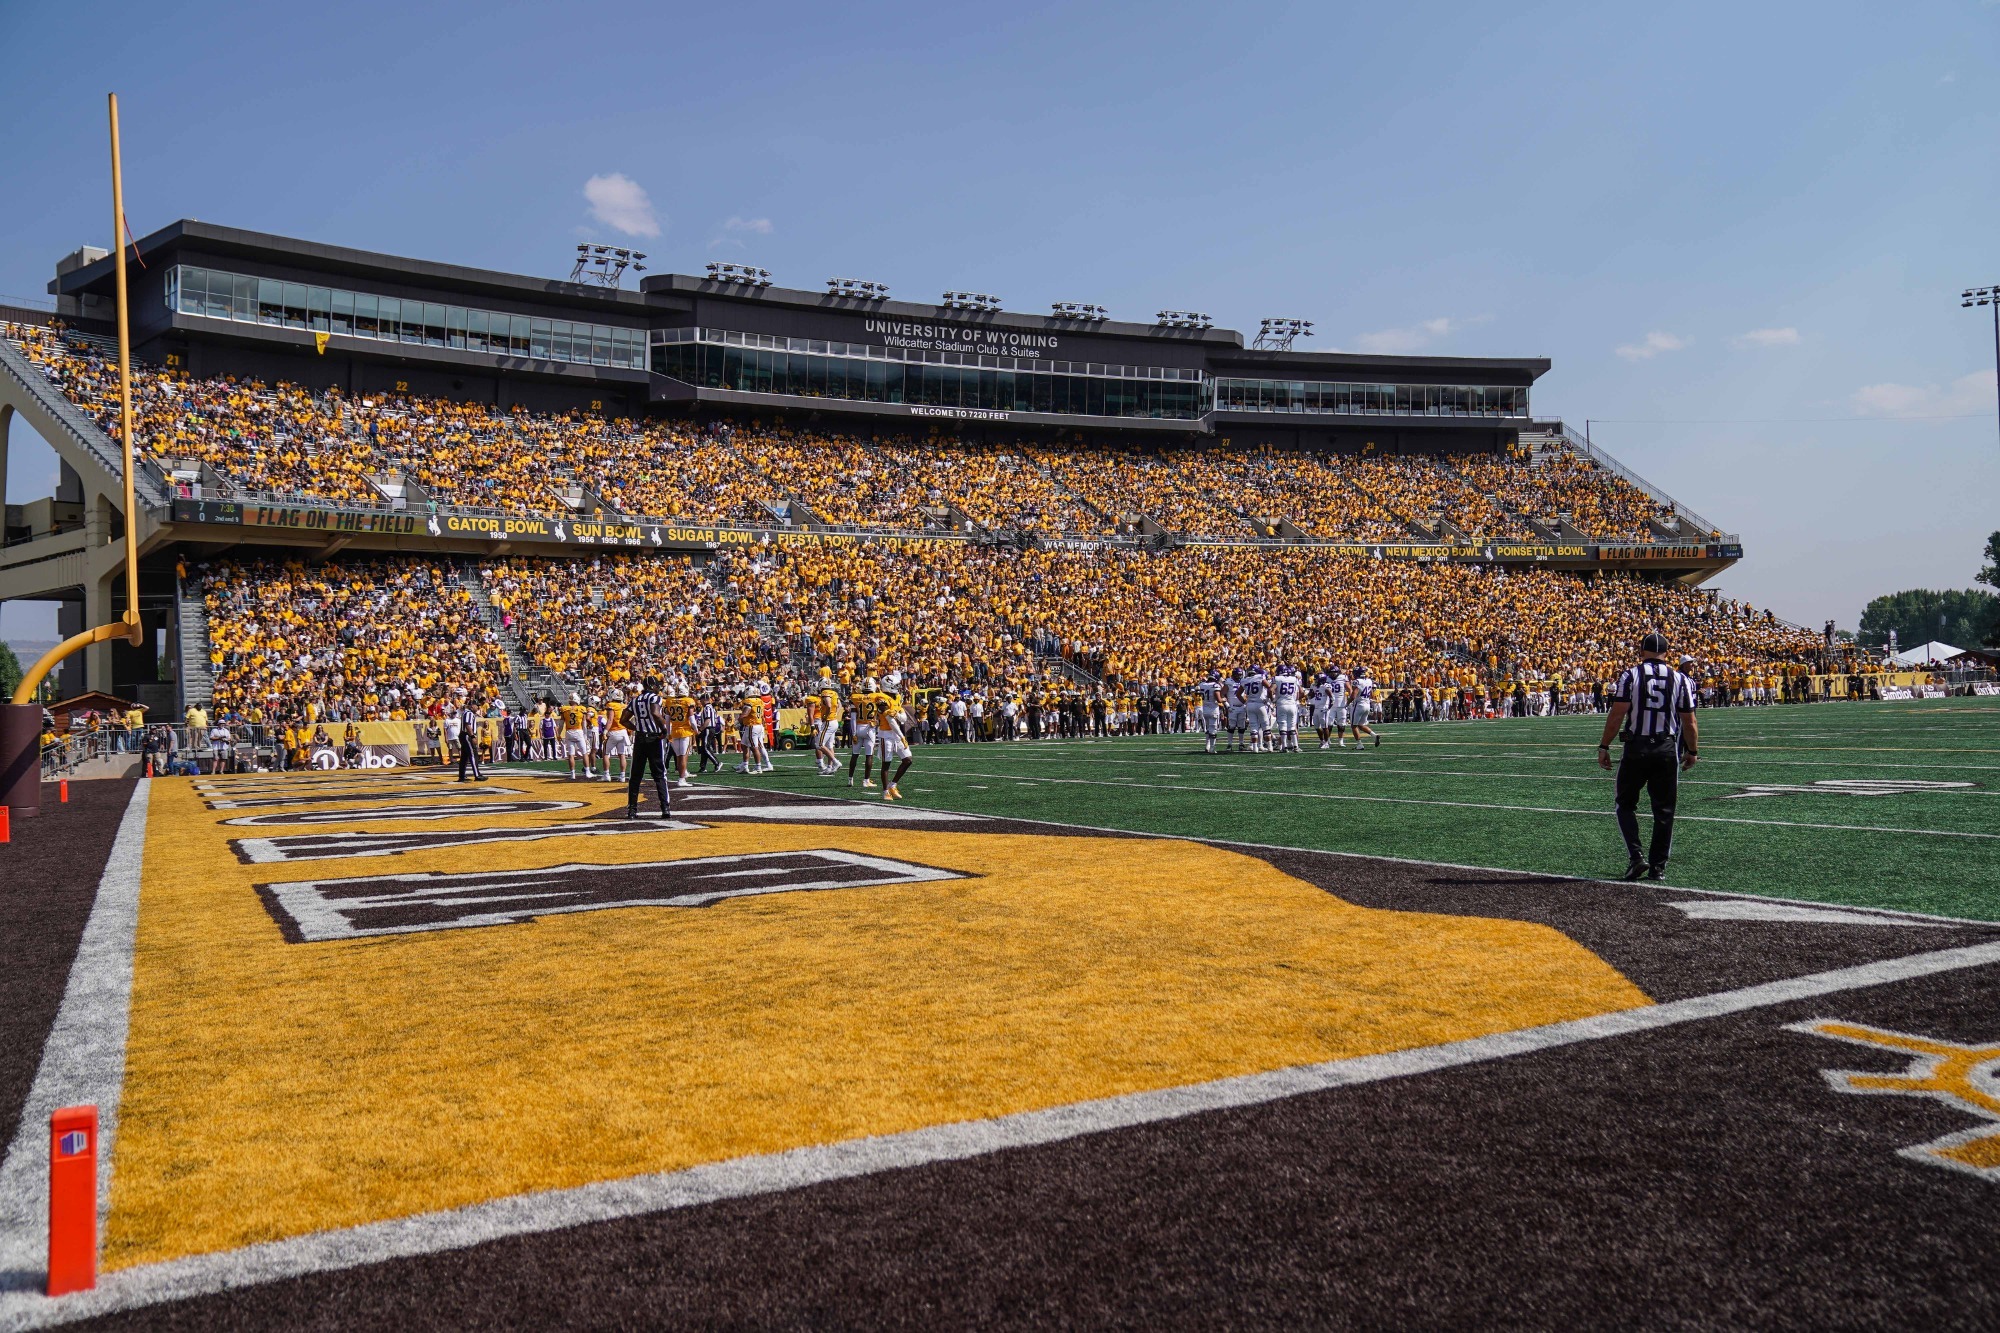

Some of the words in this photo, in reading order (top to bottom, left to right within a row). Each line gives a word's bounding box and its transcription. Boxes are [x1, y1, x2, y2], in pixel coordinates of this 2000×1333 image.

[865, 320, 957, 339] UNIVERSITY
[962, 329, 981, 341] OF
[986, 331, 1058, 348] WYOMING
[884, 335, 933, 349] Wildcatter
[935, 340, 974, 352] Stadium
[977, 343, 999, 355] Club
[1001, 345, 1008, 356] &
[1011, 346, 1040, 358] Suites
[166, 353, 179, 366] 21
[396, 381, 408, 392] 22
[591, 400, 602, 410] 23
[910, 407, 954, 417] WELCOME
[955, 410, 967, 418] TO
[969, 411, 987, 419] 7220
[989, 412, 1010, 420] FEET
[1222, 438, 1231, 446] 27
[1366, 442, 1375, 450] 28
[1506, 443, 1515, 451] 29
[257, 506, 300, 527] FLAG
[306, 510, 329, 529] ON
[336, 512, 365, 531] THE
[370, 514, 415, 533] FIELD
[448, 517, 500, 532] GATOR
[505, 520, 548, 534] BOWL
[489, 531, 508, 539] 1950
[572, 523, 601, 537] SUN
[605, 525, 646, 539] BOWL
[668, 528, 714, 542] SUGAR
[719, 531, 757, 544] BOWL
[578, 535, 595, 543] 1956
[624, 538, 641, 546] 1966
[777, 533, 820, 546] FIESTA
[1340, 547, 1369, 556] BOWL
[1386, 547, 1409, 557] NEW
[1412, 547, 1449, 557] MEXICO
[1452, 547, 1481, 556] BOWL
[1497, 546, 1555, 557] POINSETTIA
[1558, 546, 1587, 556] BOWL
[1607, 547, 1631, 559] FLAG
[1634, 547, 1647, 559] ON
[1651, 547, 1669, 558] THE
[1671, 546, 1699, 558] FIELD
[1280, 682, 1294, 695] 65
[1646, 678, 1666, 709] S
[669, 706, 685, 721] 23
[858, 702, 875, 720] 12
[569, 712, 577, 726] 3
